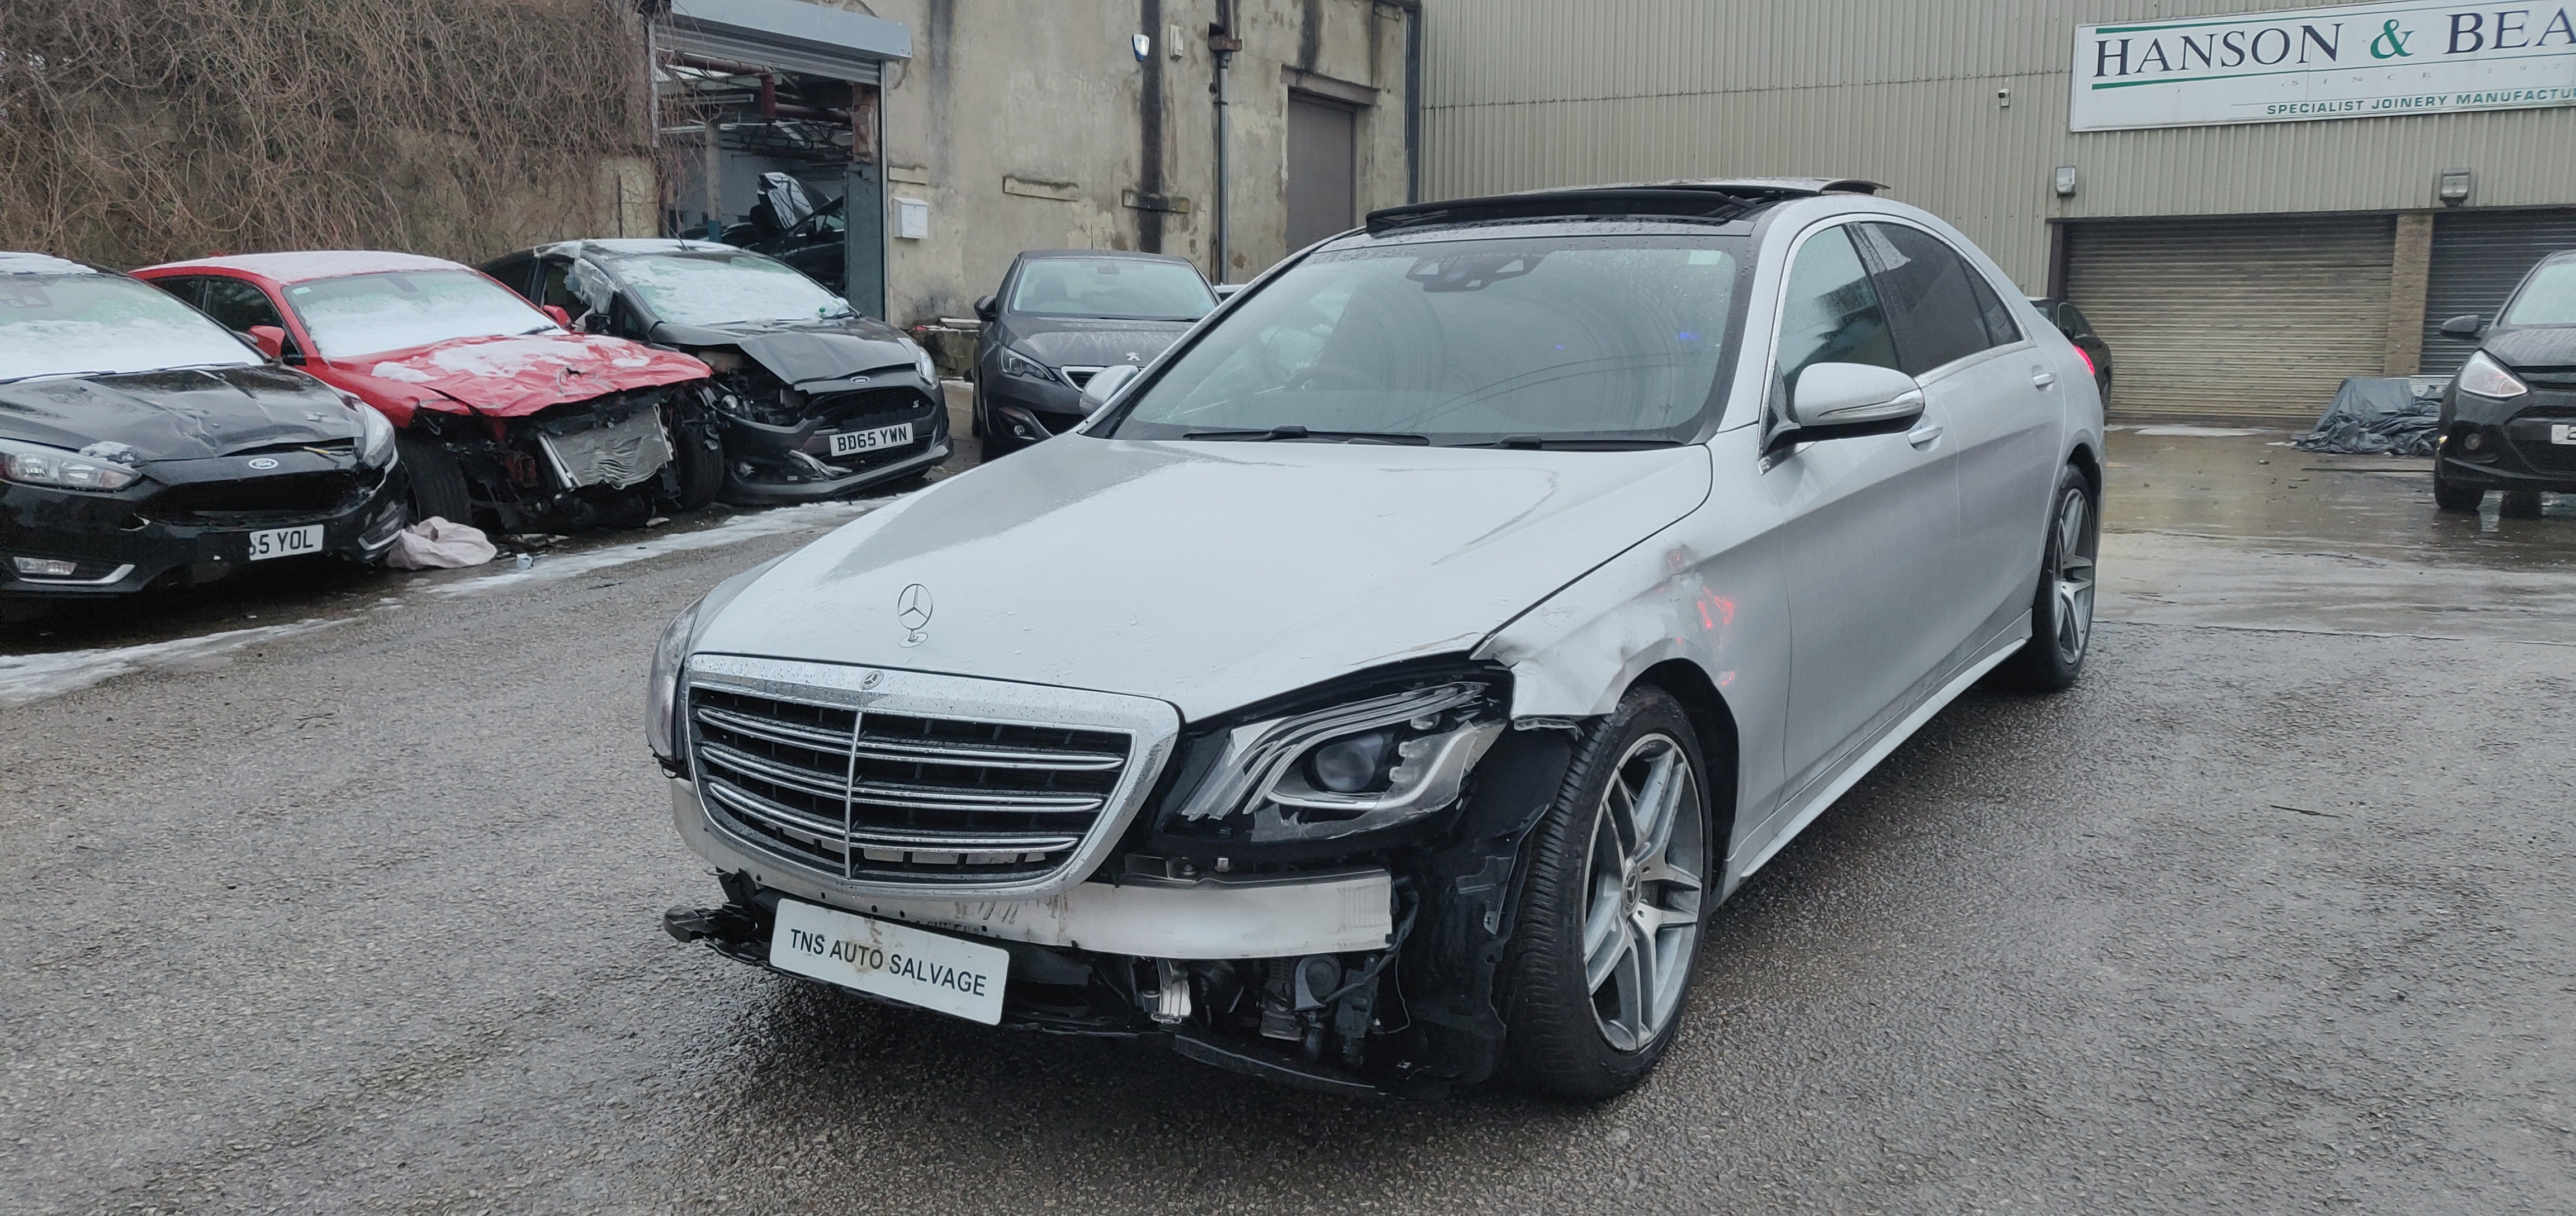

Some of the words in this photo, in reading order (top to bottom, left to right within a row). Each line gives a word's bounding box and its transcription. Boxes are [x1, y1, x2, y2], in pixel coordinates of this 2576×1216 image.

[2092, 23, 2345, 77] HANSON
[2370, 19, 2415, 59] &
[2442, 7, 2576, 55] BEA
[2267, 99, 2365, 115] SPECIALIST
[2371, 95, 2449, 110] JOINERY
[837, 431, 876, 452] BD65
[880, 426, 907, 444] YWN
[277, 530, 313, 552] YOL
[790, 929, 826, 955] TNS
[830, 939, 883, 970] AUTO
[889, 953, 987, 998] SALVAGE
